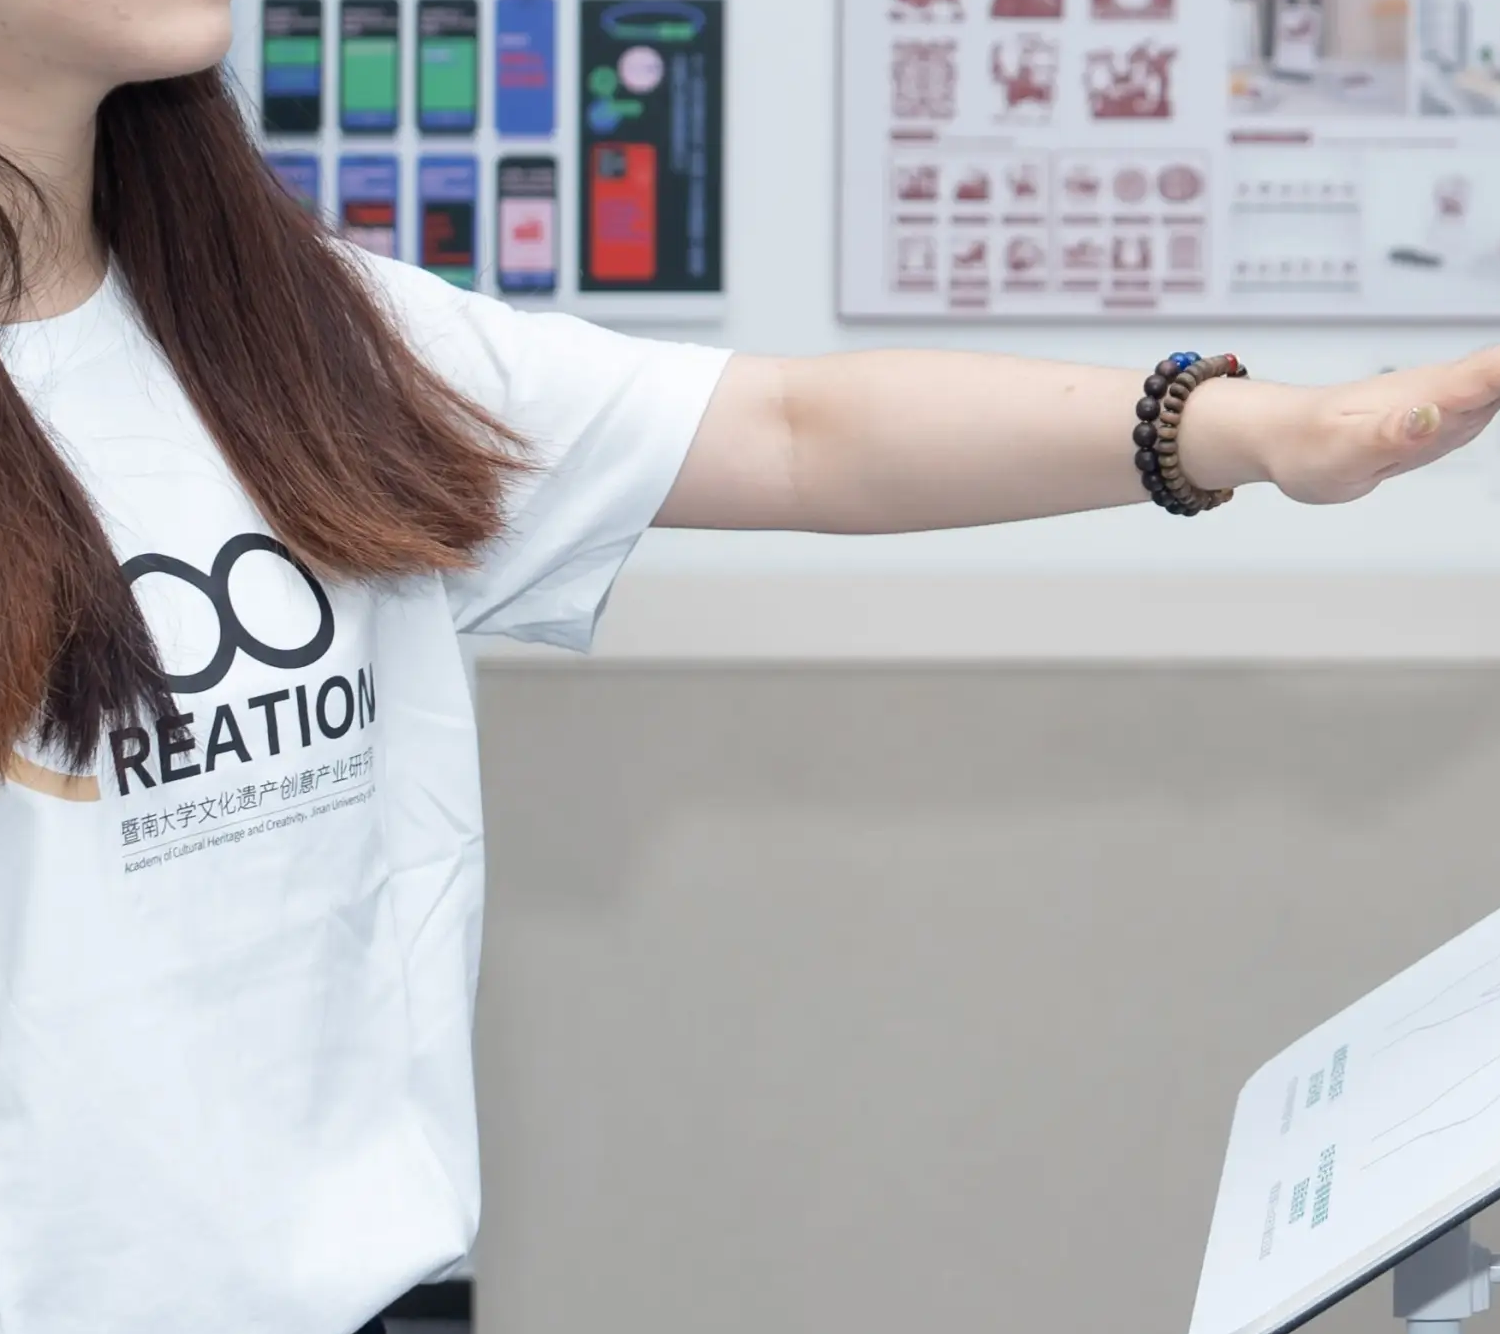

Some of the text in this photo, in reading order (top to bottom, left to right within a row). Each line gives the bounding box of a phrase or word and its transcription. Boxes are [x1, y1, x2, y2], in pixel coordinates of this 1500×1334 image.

[124, 853, 162, 875] Academy
[173, 839, 206, 859] Cultural
[207, 827, 247, 848] Heritage
[247, 820, 265, 836] and
